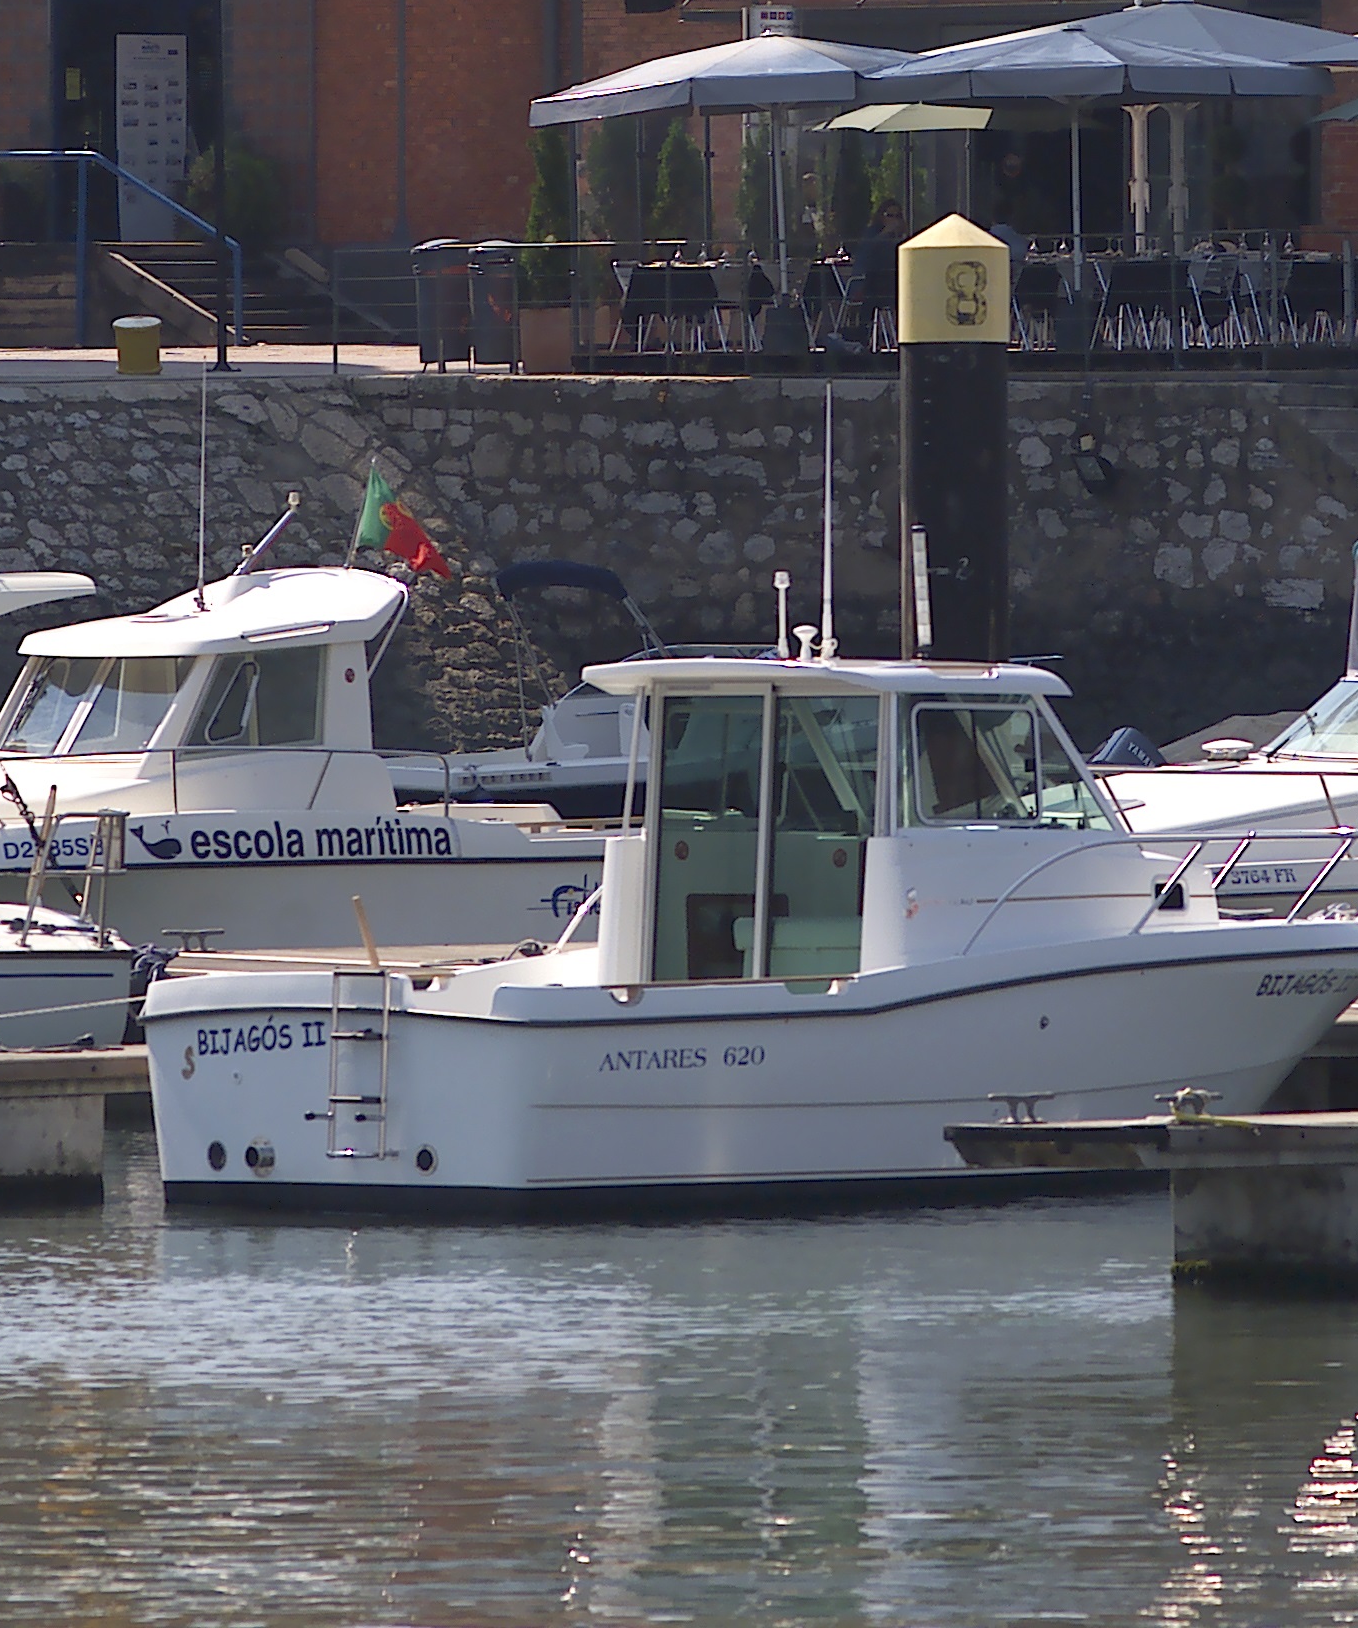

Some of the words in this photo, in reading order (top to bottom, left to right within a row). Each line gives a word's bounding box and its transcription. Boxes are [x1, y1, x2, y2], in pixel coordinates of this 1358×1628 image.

[945, 260, 987, 326] 8
[4, 837, 104, 860] D285SB
[191, 821, 304, 859] escola
[315, 816, 452, 857] marítima
[197, 1014, 293, 1056] BIJAGÓS
[301, 1021, 327, 1048] II
[599, 1047, 708, 1072] ANTARES
[723, 1045, 766, 1067] 620
